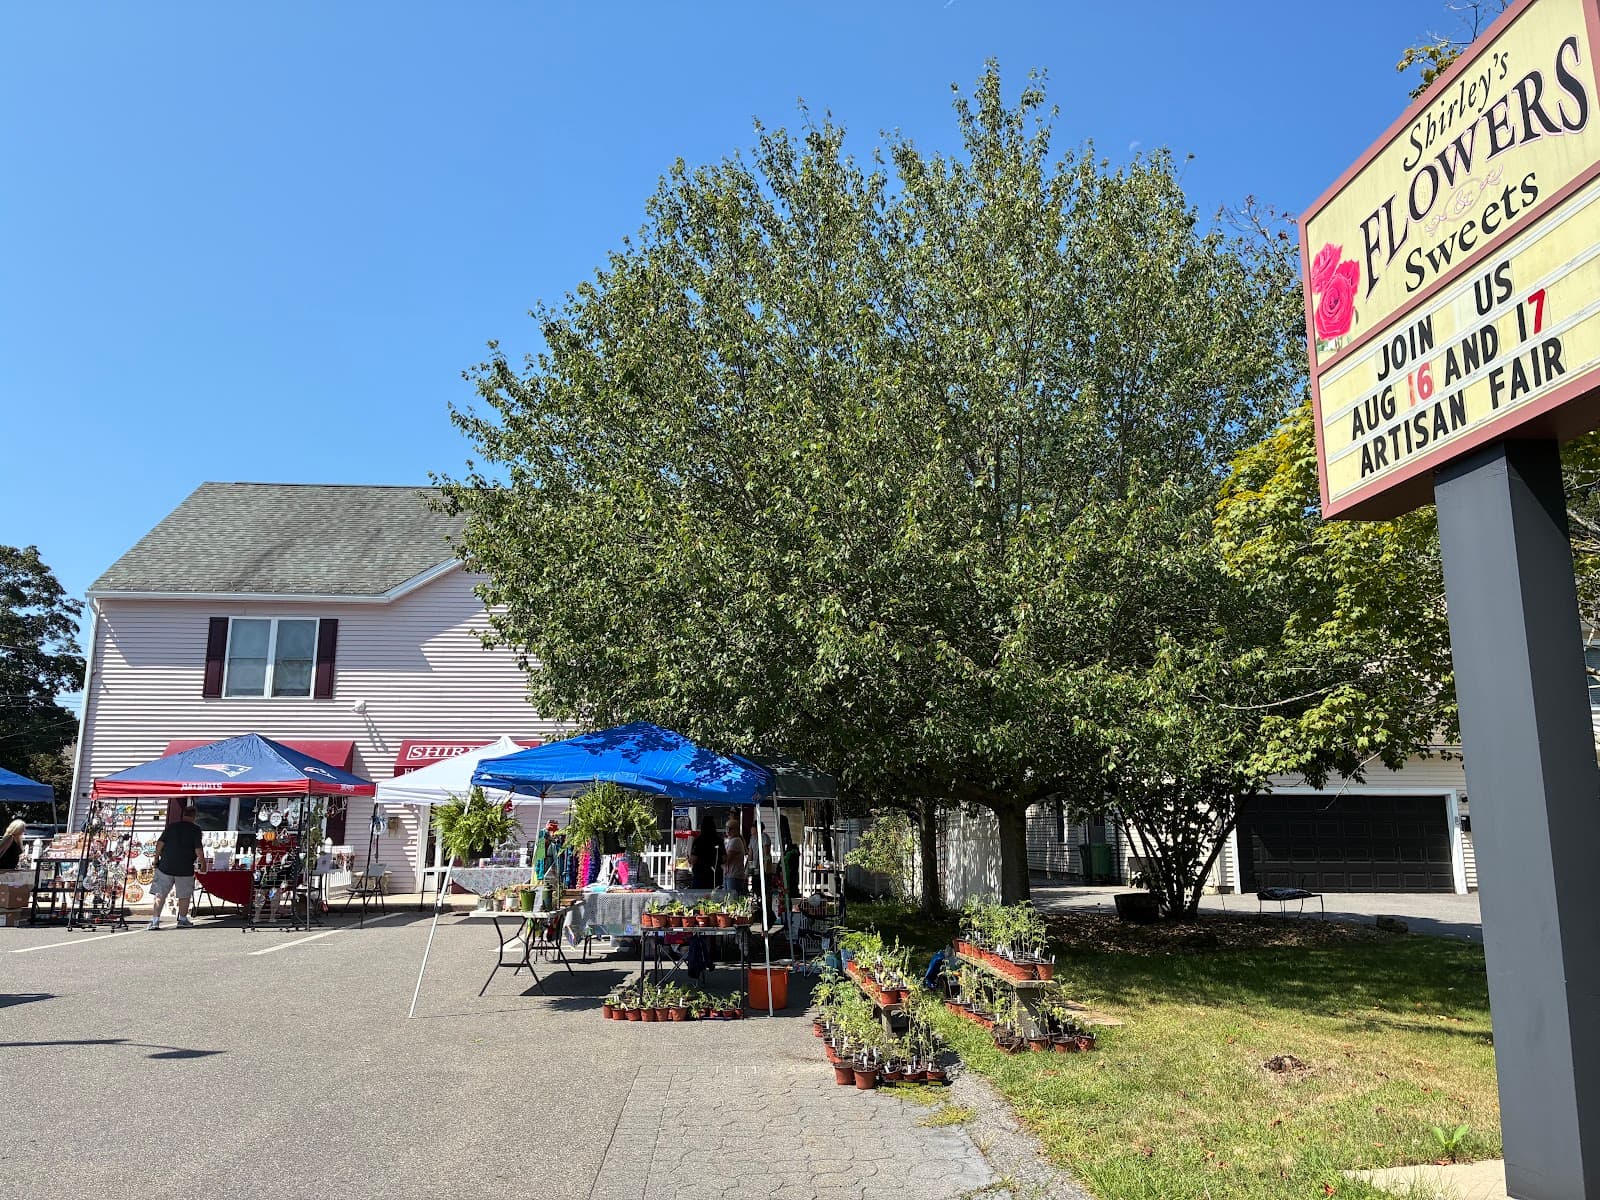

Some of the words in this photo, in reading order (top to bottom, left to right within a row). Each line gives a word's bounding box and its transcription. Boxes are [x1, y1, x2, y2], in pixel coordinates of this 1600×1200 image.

[1359, 36, 1589, 300] FLOWERS
[1402, 52, 1509, 172] Shirley's
[1405, 172, 1540, 294] Sweets
[1352, 384, 1397, 441] AUG
[1407, 362, 1434, 407] 16
[1444, 324, 1498, 387] AND
[1516, 287, 1546, 343] 17
[1377, 314, 1434, 381] JOIN
[1473, 260, 1514, 316] US
[1360, 388, 1467, 478] ARTISAN
[1488, 337, 1566, 410] FAIR
